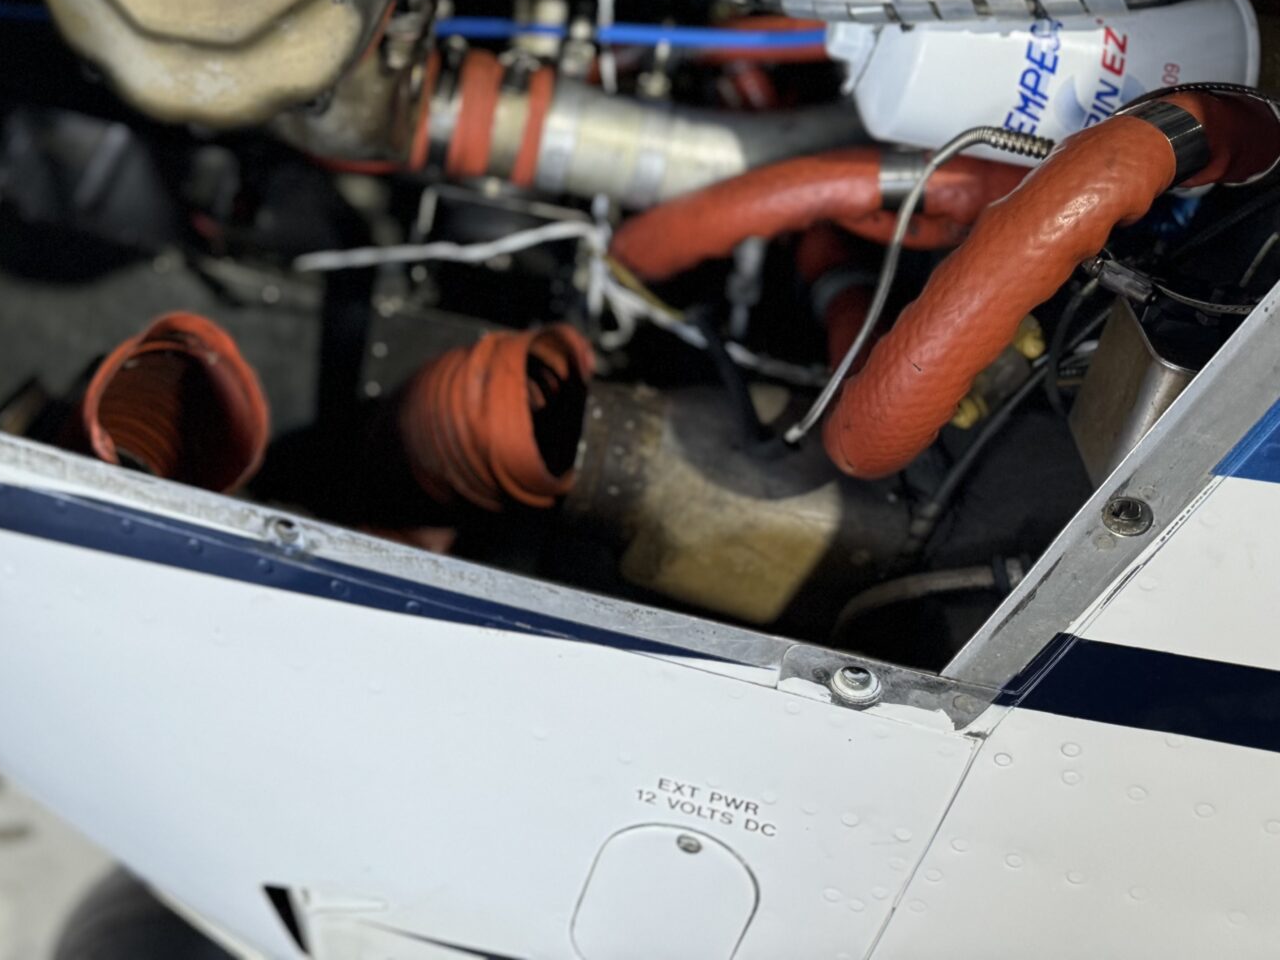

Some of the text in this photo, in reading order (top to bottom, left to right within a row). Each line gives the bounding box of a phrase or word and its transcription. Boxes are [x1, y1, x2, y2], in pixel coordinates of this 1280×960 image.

[636, 789, 777, 837] 12 VOLTS DC
[657, 778, 760, 815] EXT PWR
